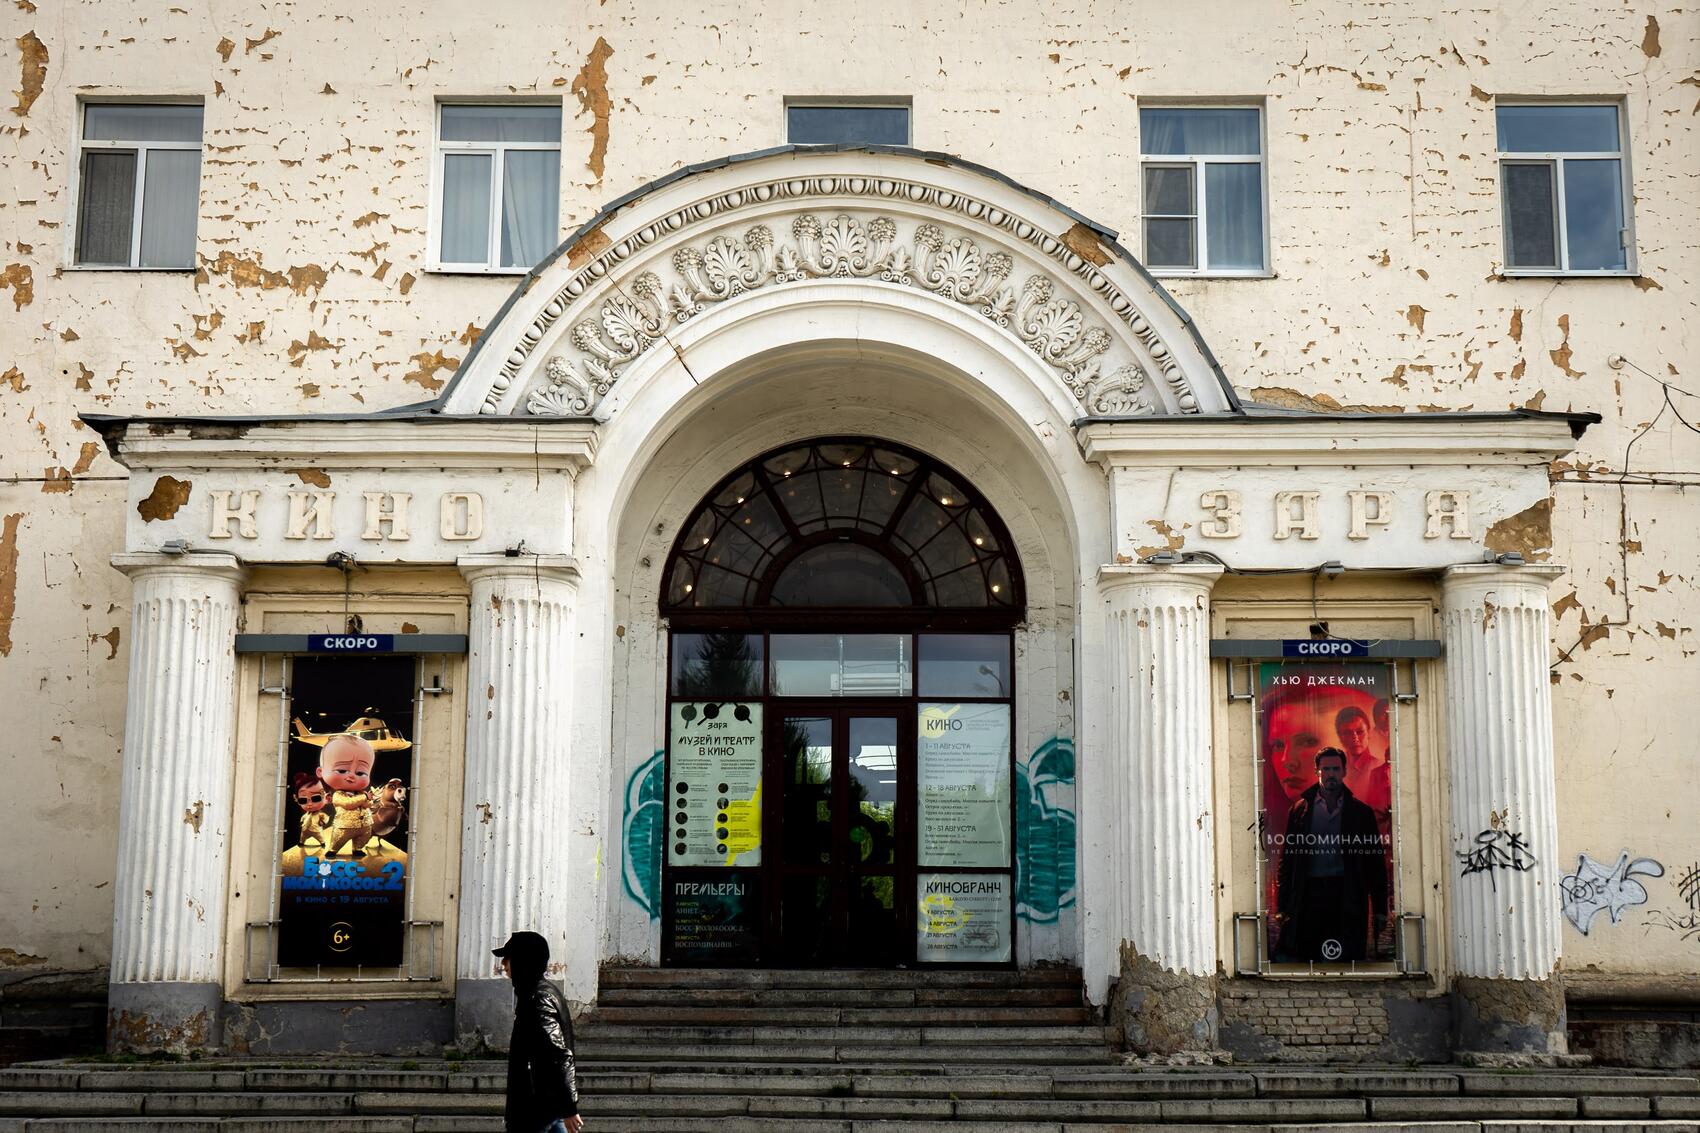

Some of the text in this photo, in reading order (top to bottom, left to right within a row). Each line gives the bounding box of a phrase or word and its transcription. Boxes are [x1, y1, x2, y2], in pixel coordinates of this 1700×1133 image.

[208, 489, 483, 541] КИНО
[1200, 490, 1472, 540] ЗАРЯ
[324, 637, 378, 649] СКОРО
[1298, 642, 1352, 655] СКОРО
[1272, 675, 1376, 687] ХЬЮ ДЖЕКМАН
[926, 719, 963, 731] КИНО
[677, 734, 756, 747] МУЗЕЙ И ТЕАТР
[698, 746, 735, 756] В КИНО
[1267, 833, 1391, 845] ВОСПОМИНАНИЯ
[381, 861, 405, 890] 2
[675, 882, 745, 896] ПРЕМЬЕРЫ
[926, 882, 1001, 894] КИНОБРАНЧ
[305, 896, 328, 904] КИНО
[340, 896, 350, 904] 19
[353, 896, 389, 904] АВГУСТА
[333, 930, 350, 944] 6+
